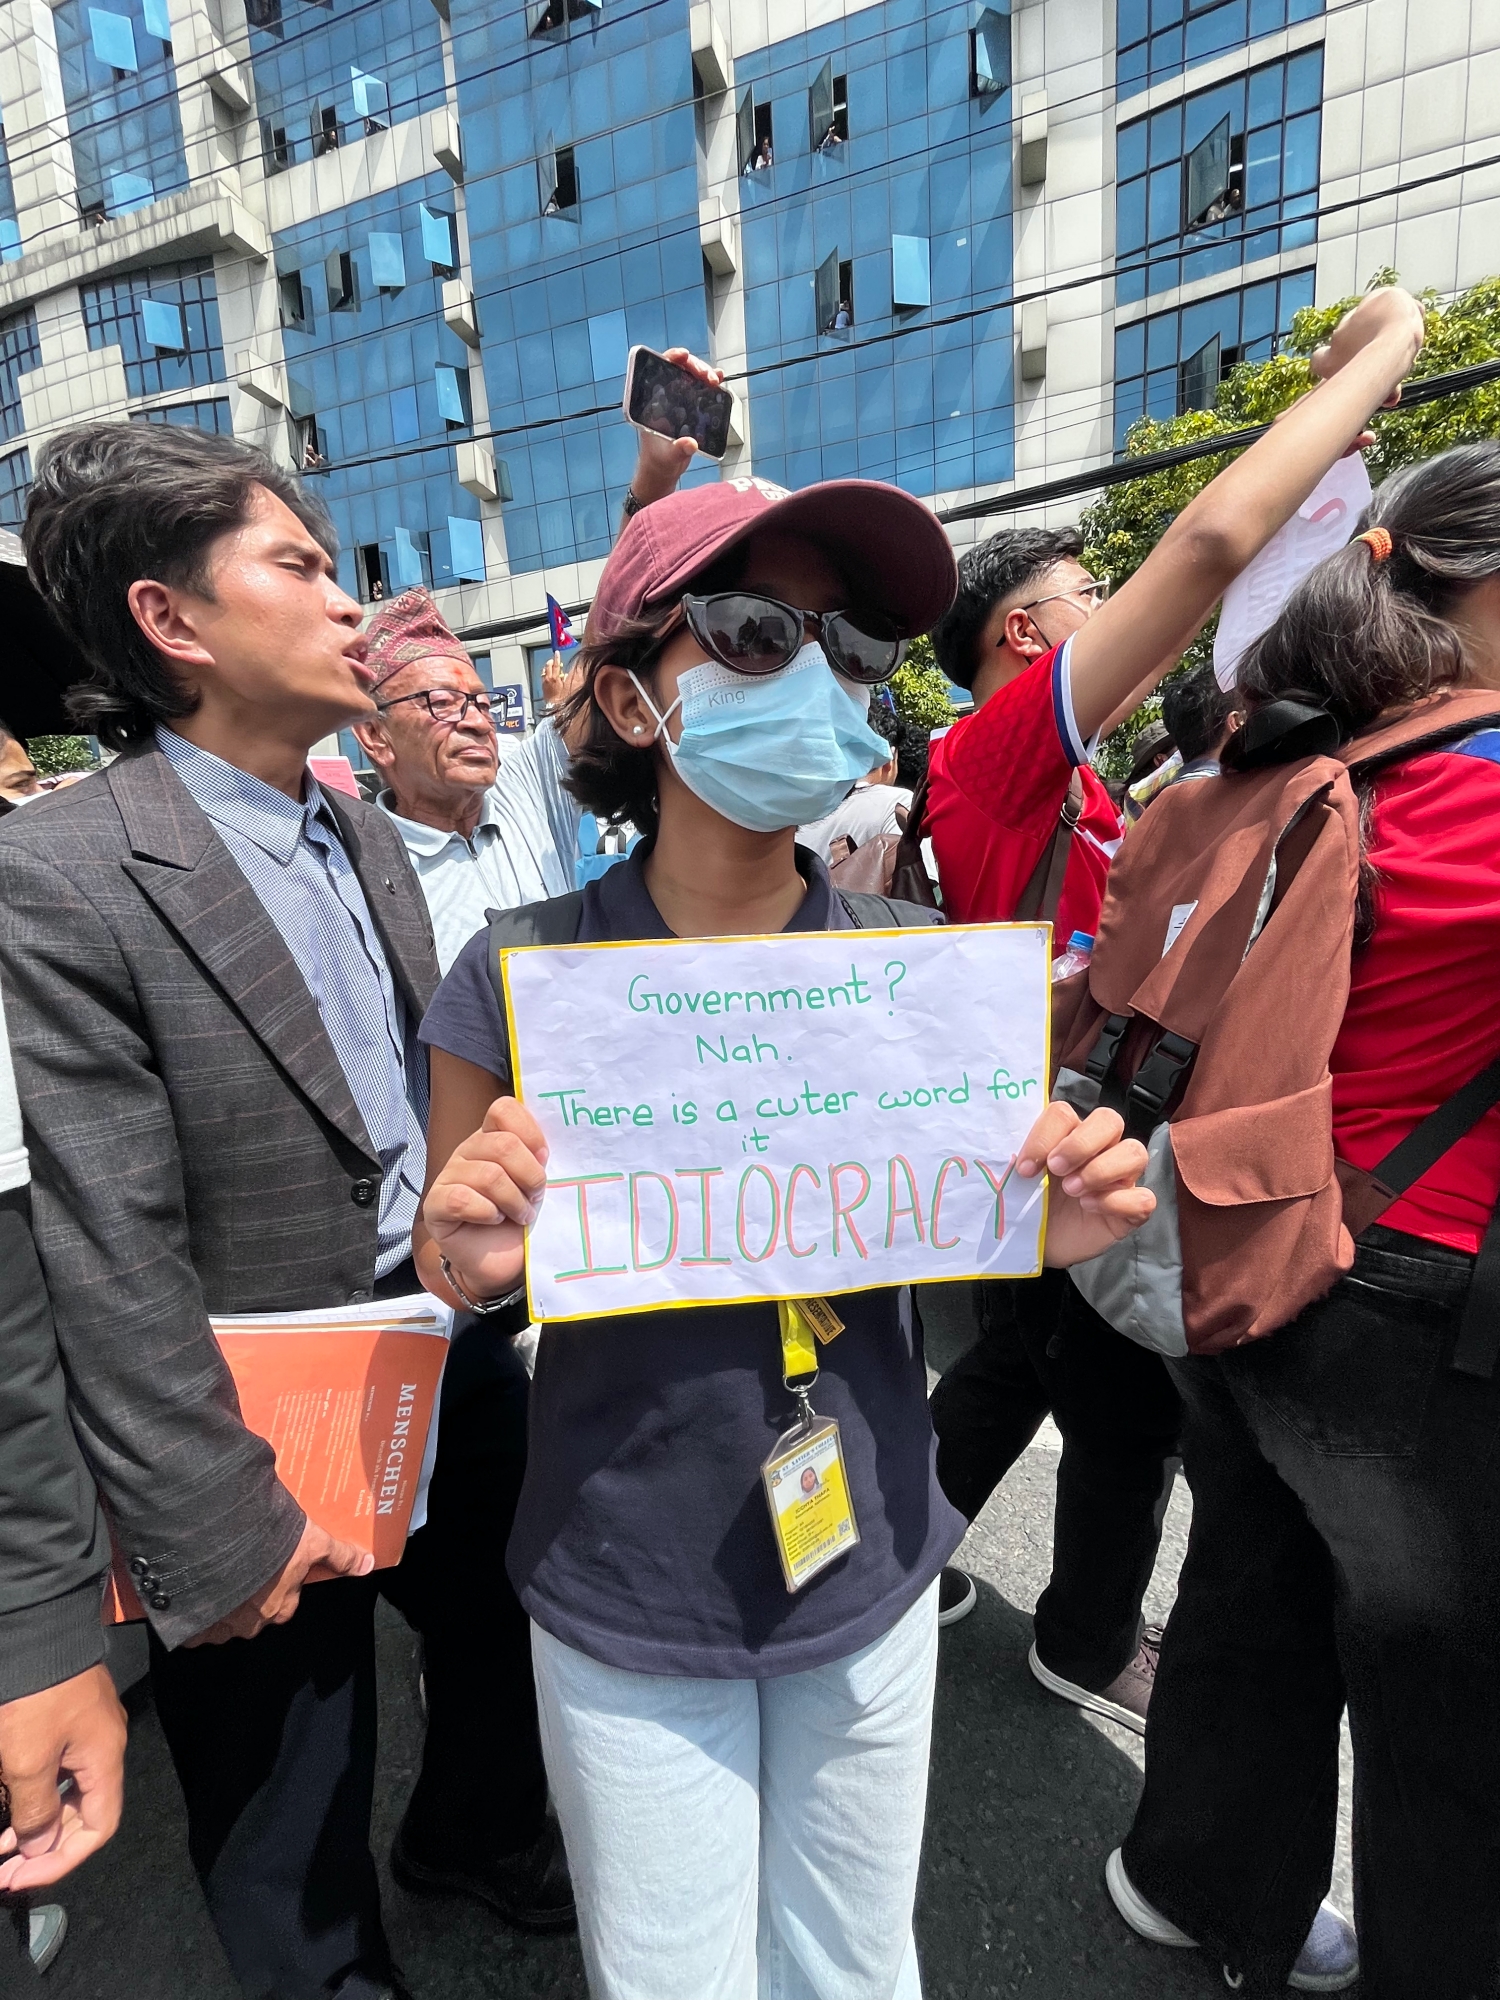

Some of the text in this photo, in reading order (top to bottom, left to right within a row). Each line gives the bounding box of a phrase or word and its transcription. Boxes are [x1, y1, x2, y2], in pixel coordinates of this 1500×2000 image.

[708, 690, 746, 708] King
[695, 1034, 793, 1064] Nah.
[537, 1068, 1038, 1127] There is a cuter word for
[741, 1127, 770, 1153] it
[546, 1153, 1019, 1283] IDIOCRACY
[376, 1383, 417, 1515] MENSCHEN
